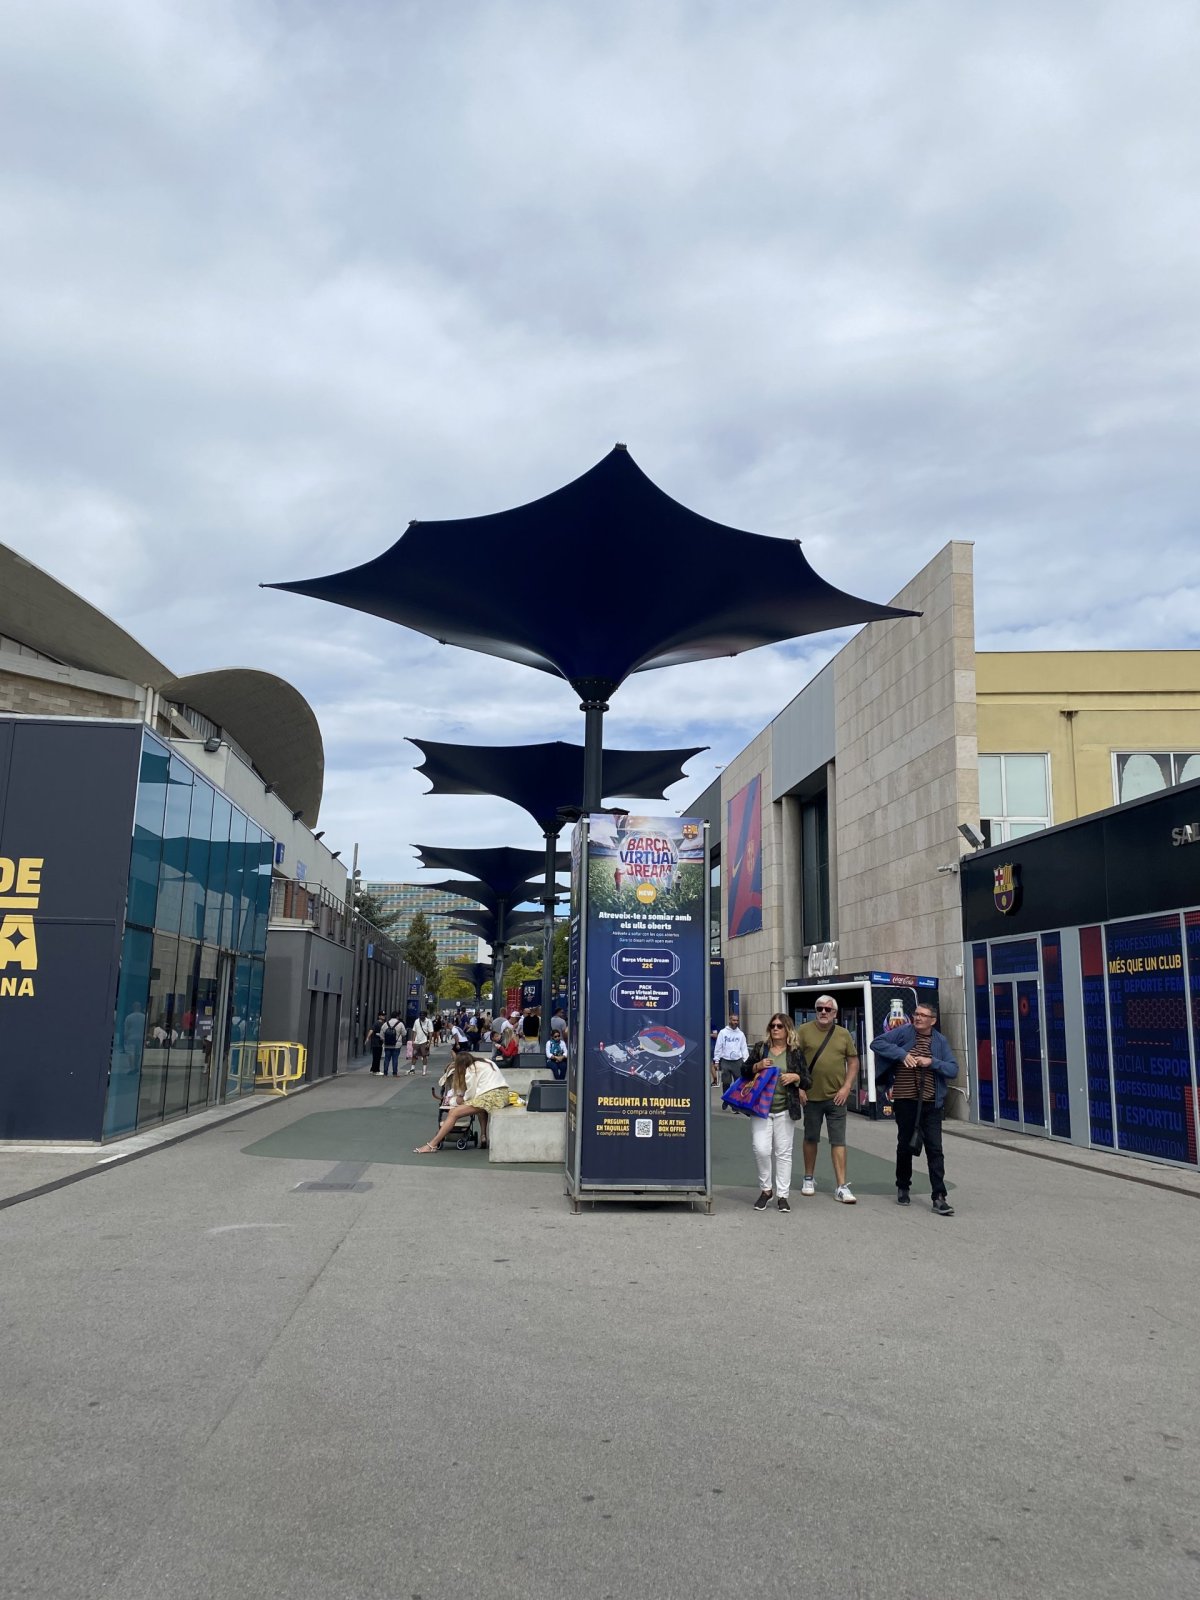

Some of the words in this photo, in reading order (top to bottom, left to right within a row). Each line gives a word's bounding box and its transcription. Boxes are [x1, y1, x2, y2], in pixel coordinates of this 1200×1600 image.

[627, 838, 670, 852] BARÇA
[620, 851, 678, 864] VIRTUAL
[626, 864, 672, 878] DREAM
[598, 912, 642, 920] Atreveix-te
[648, 913, 674, 921] somiar
[675, 914, 692, 922] amb
[1115, 933, 1174, 952] PROFESSIONAL
[1108, 956, 1126, 974] MÉS
[1127, 957, 1143, 975] QUE
[1145, 956, 1157, 971] UN
[1158, 954, 1182, 970] CLUB
[0, 978, 34, 996] NA
[1124, 979, 1163, 992] DEPORTE
[1150, 1057, 1190, 1077] ESPOR
[1116, 1080, 1181, 1100] ROFESSIONALS
[598, 1097, 640, 1107] PREGUNTA
[642, 1098, 648, 1107] A
[650, 1098, 690, 1108] TAQUILLES
